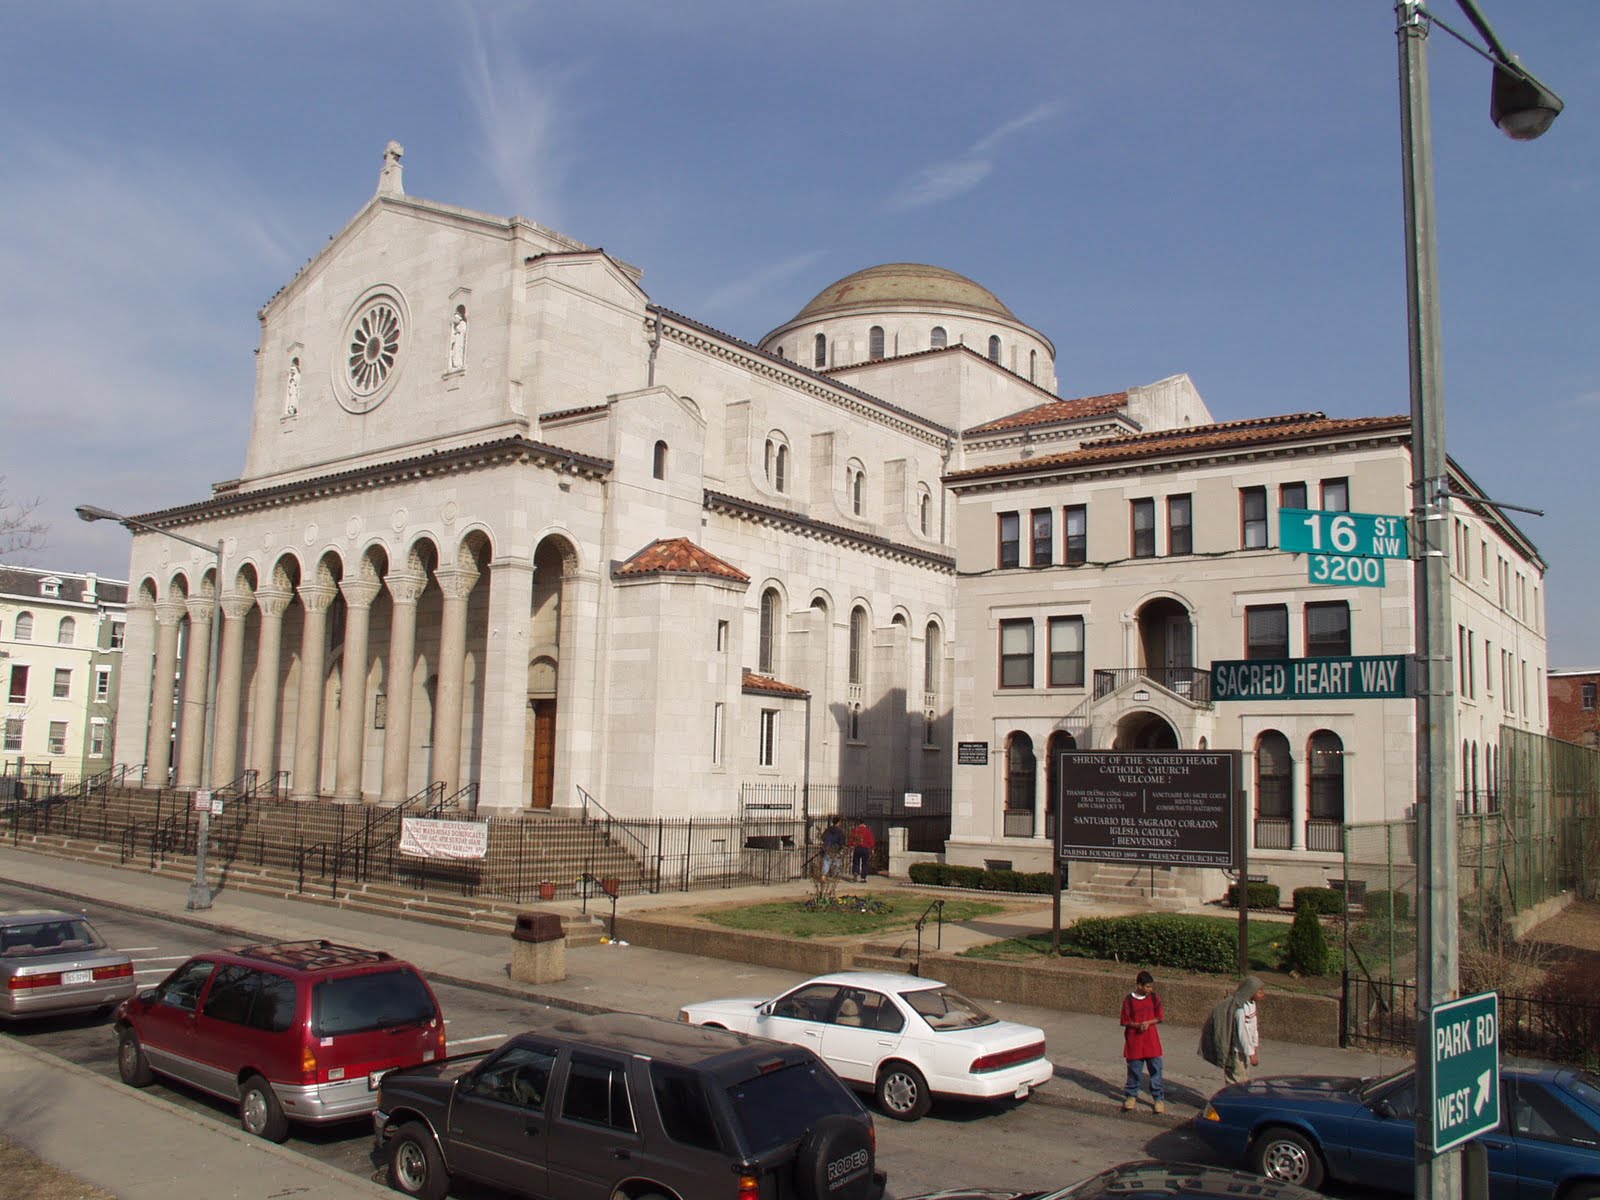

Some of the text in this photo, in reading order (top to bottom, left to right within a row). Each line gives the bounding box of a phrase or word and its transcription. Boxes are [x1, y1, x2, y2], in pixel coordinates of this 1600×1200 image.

[1304, 514, 1356, 552] 16
[1374, 518, 1398, 536] ST
[1372, 537, 1400, 556] NW
[1314, 556, 1380, 582] 3200
[1216, 660, 1398, 696] SACRED HEART WAY
[1072, 756, 1219, 765] SHRINE OF THE SACRED HEART
[1100, 766, 1189, 775] CATHOLIC CHURCH
[1118, 776, 1165, 784] WELCOME
[1074, 817, 1218, 828] SANTUARIO DEL SAGRADO CORAZON
[1110, 827, 1180, 837] IGLESIA CATOLICA
[1117, 837, 1172, 846] BIENVENIDOS
[1436, 1013, 1494, 1061] PARK RD
[1438, 1087, 1470, 1131] WEST
[828, 1149, 868, 1180] RODEO
